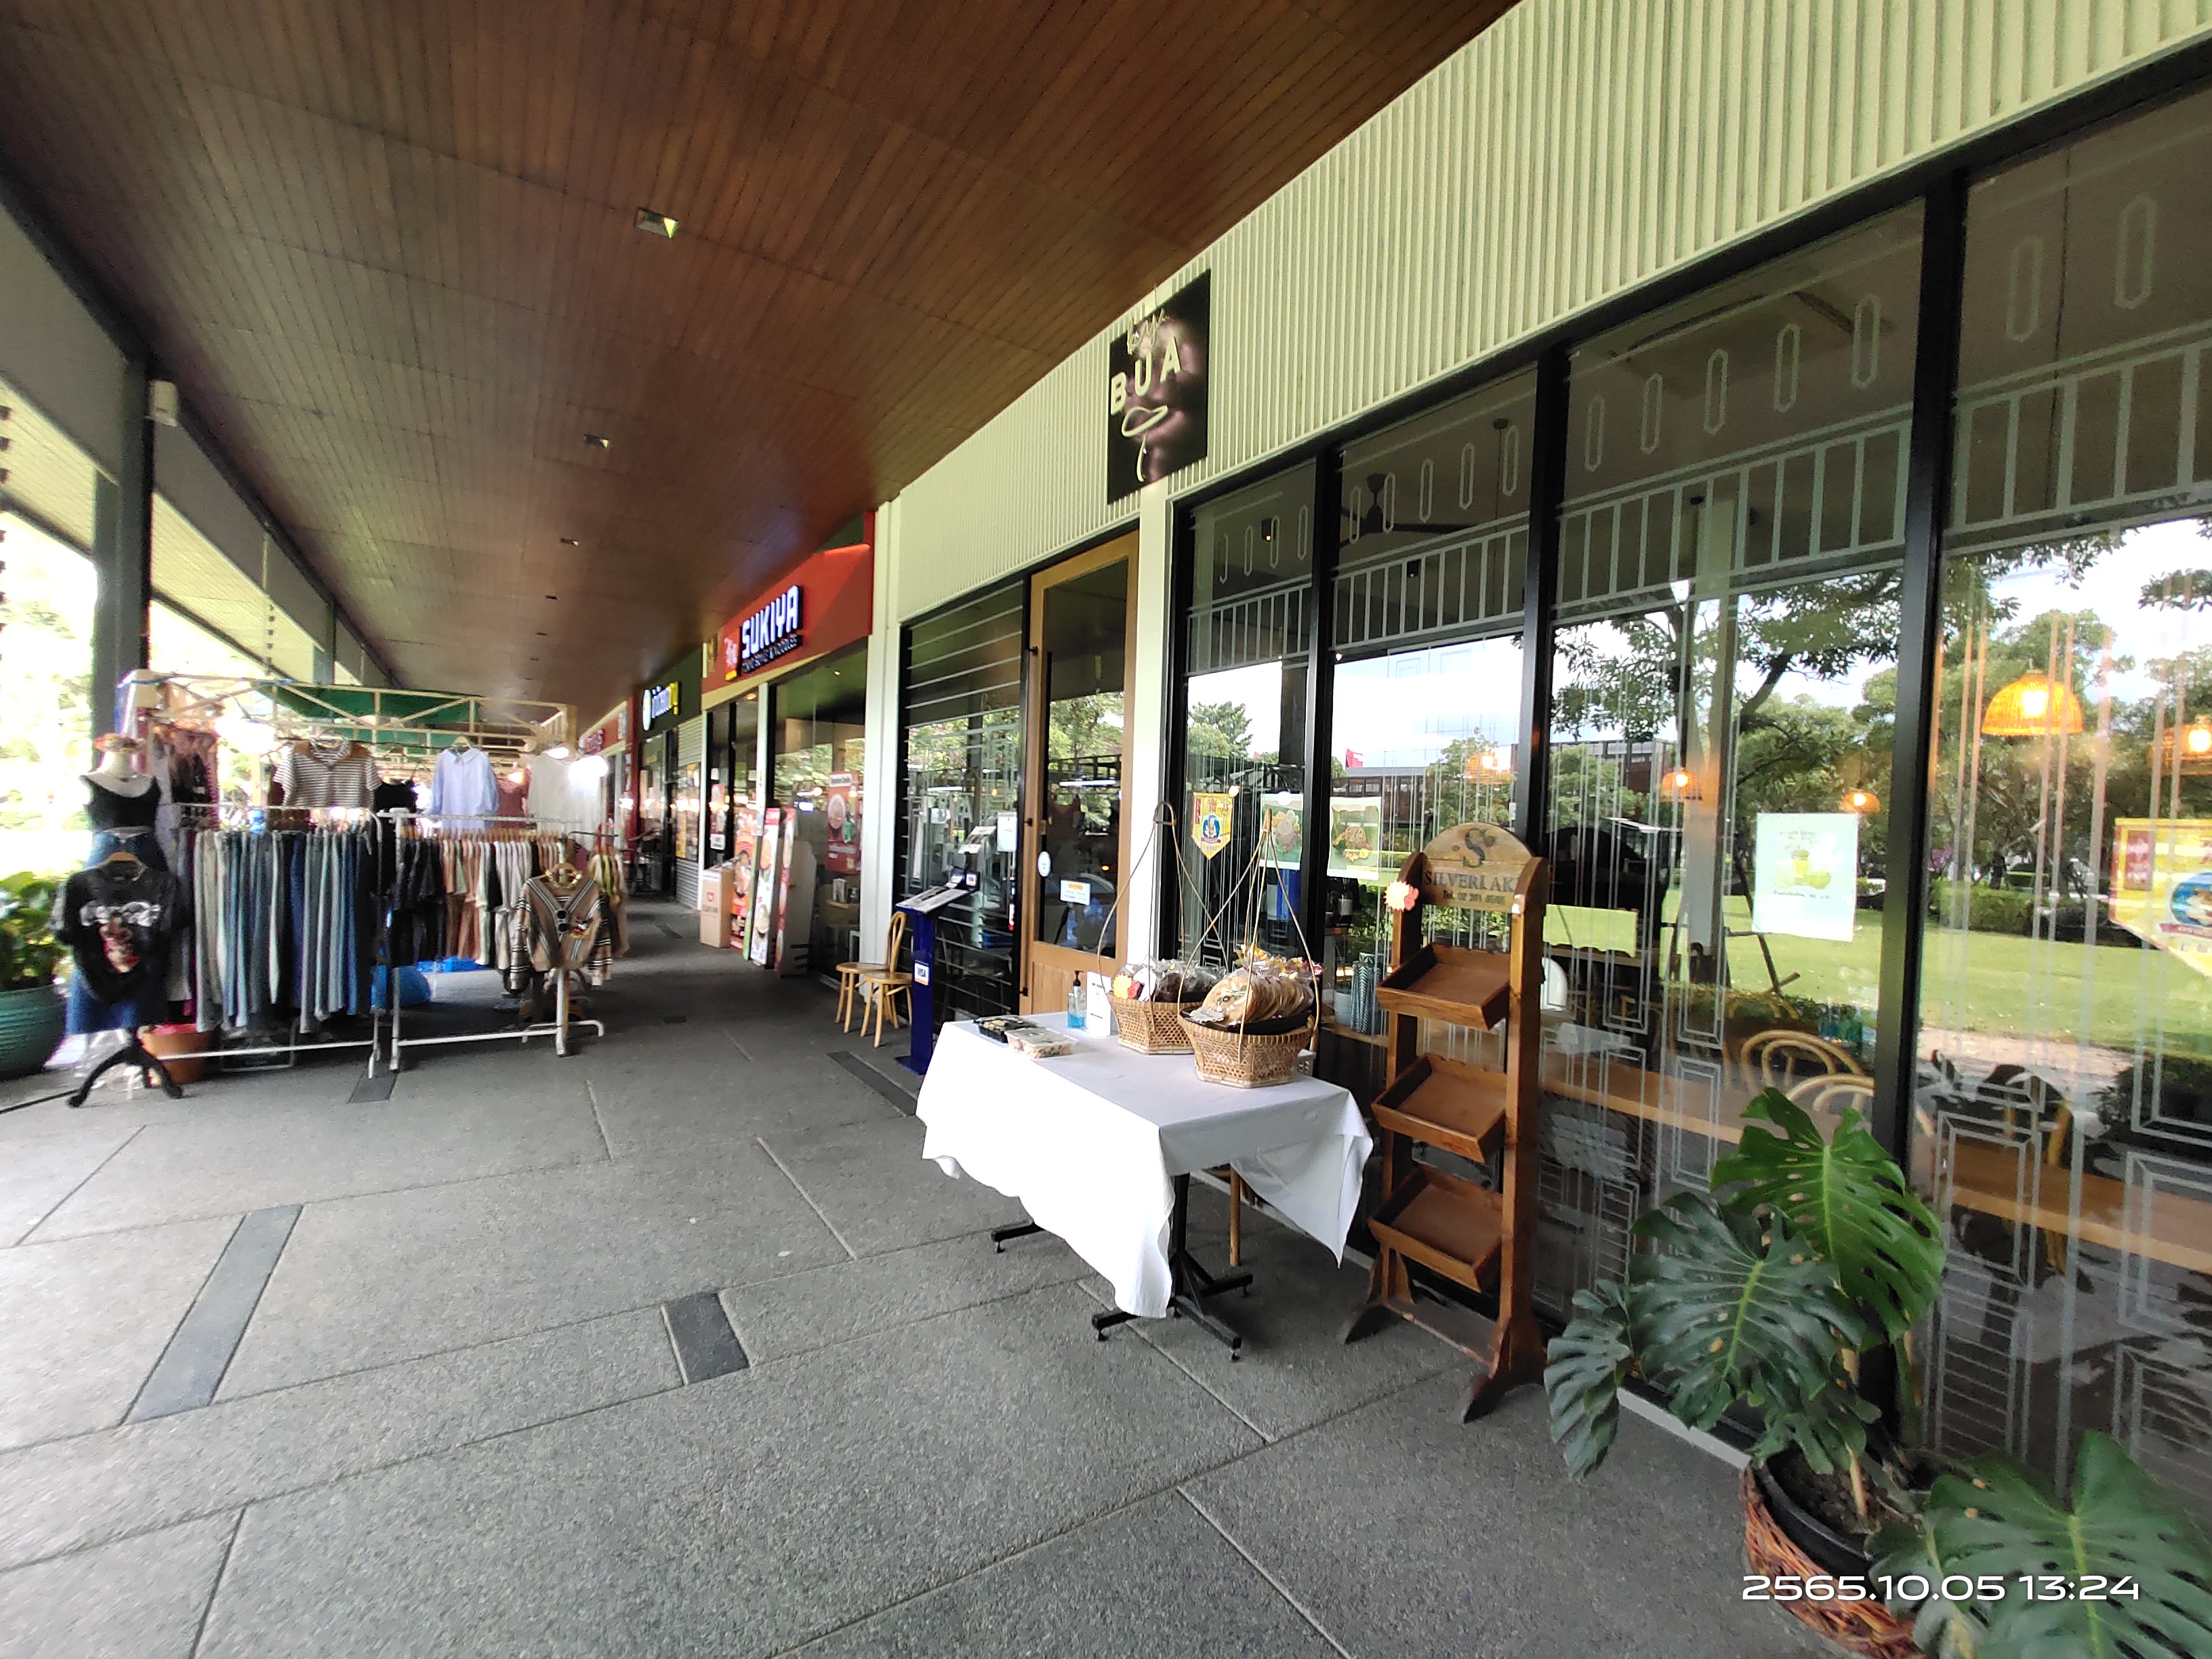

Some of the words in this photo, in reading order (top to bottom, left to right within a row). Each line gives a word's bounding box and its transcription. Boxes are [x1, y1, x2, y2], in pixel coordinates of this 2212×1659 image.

[1111, 336, 1181, 415] BUA
[742, 584, 799, 659] SUKIYA
[1425, 870, 1518, 893] SILVERLAK
